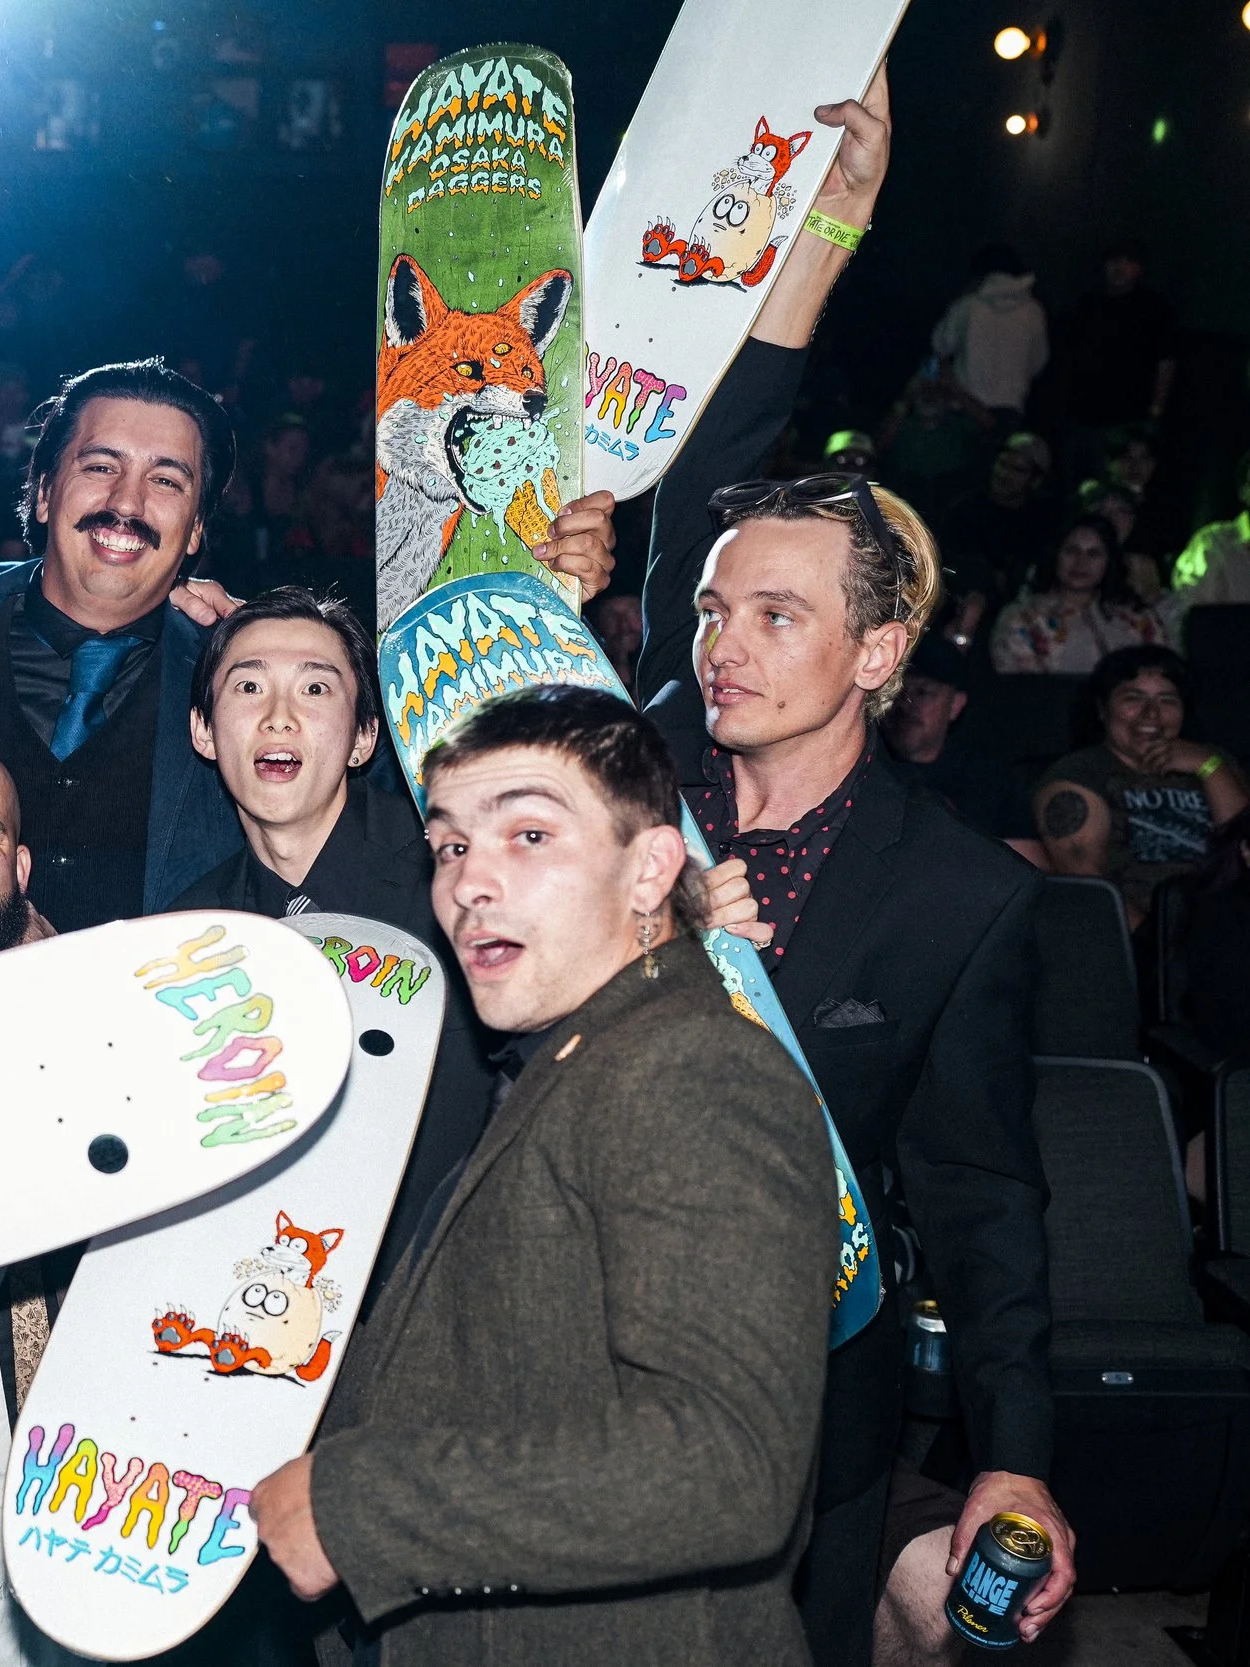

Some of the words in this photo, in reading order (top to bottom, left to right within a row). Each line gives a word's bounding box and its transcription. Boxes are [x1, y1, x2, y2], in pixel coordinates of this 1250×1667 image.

[391, 57, 567, 161] HAYATE
[385, 110, 565, 197] KAMIMURA
[428, 147, 528, 181] OSAKA
[406, 171, 542, 214] DAGGERS
[833, 230, 851, 243] DIE
[585, 341, 688, 443] YATE
[306, 936, 432, 1005] ROIN
[134, 925, 298, 1148] HEROIN
[16, 1423, 251, 1566] HAYATE
[961, 1577, 1007, 1617] LIFE
[964, 1551, 1019, 1609] RANGE
